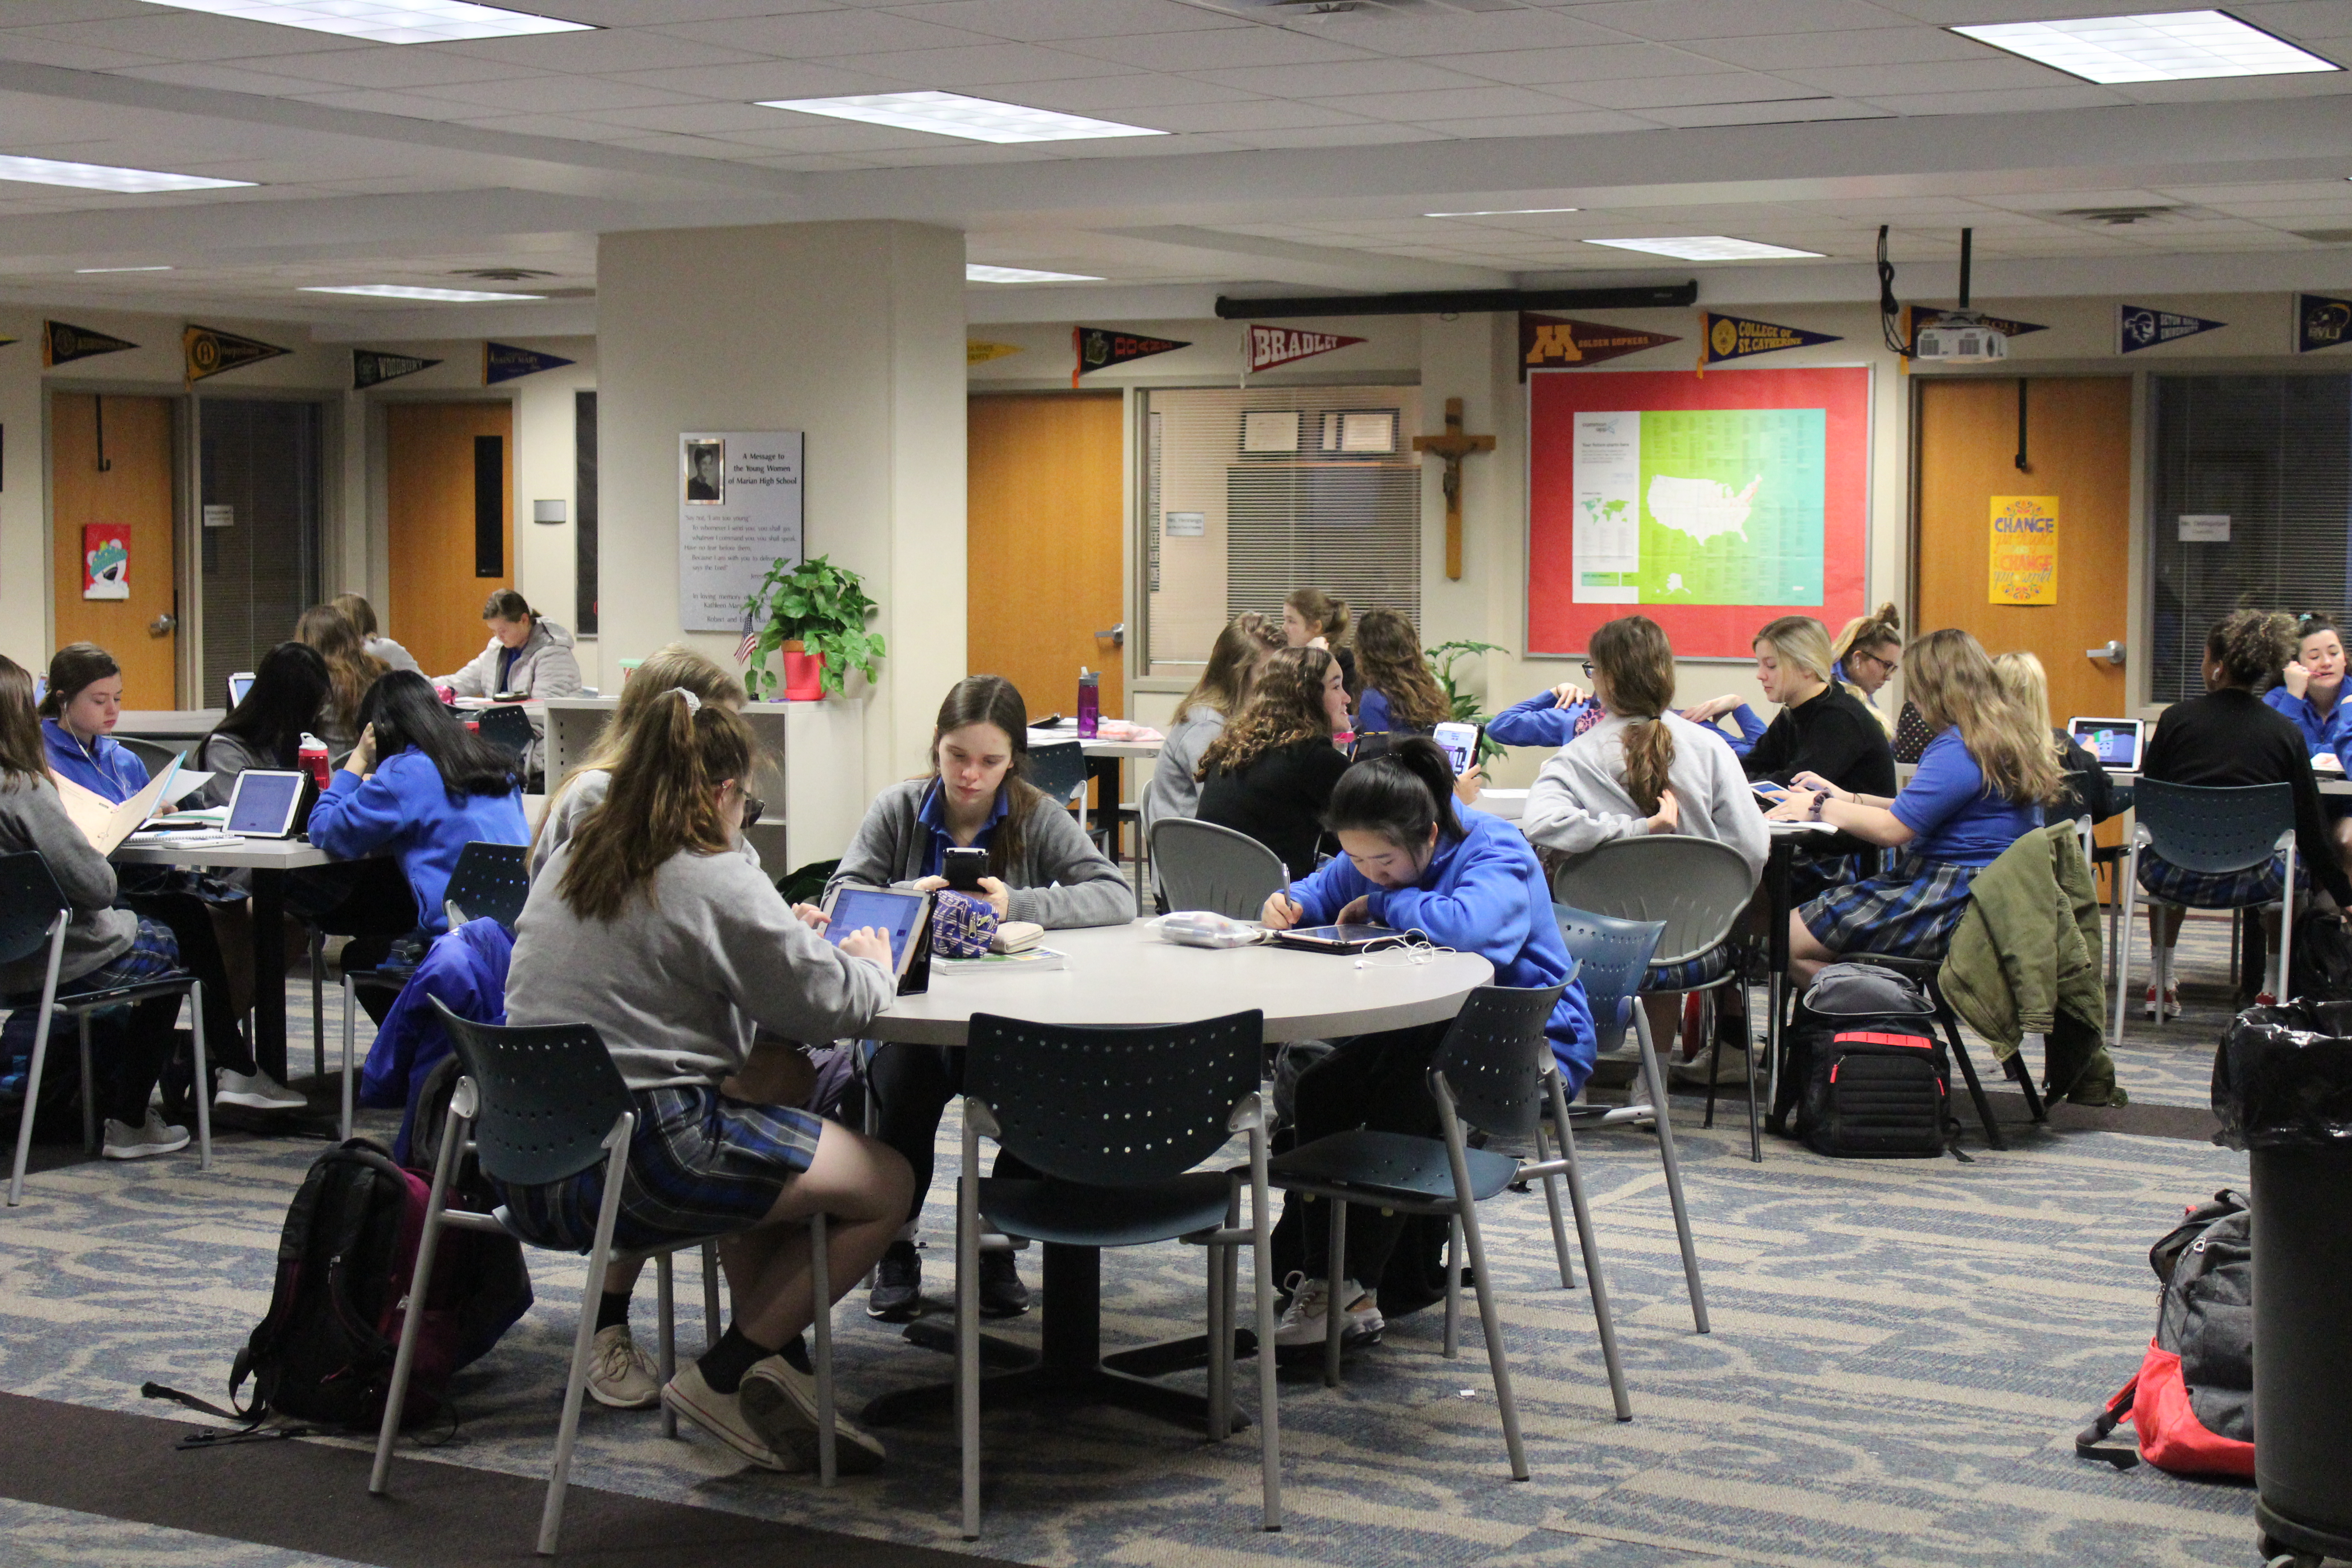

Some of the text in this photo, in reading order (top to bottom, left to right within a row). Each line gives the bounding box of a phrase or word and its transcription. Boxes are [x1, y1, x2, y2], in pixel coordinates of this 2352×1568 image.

[1739, 321, 1793, 338] COLLEGE OF
[1253, 328, 1338, 367] BRADLEY
[1578, 336, 1649, 348] GOLDEN GOPHERS
[1752, 338, 1804, 351] CATHERINE
[378, 357, 423, 379] WOODBURY
[750, 453, 776, 461] Message
[746, 466, 764, 474] Young
[760, 478, 774, 486] High
[1994, 517, 2055, 533] CHANGE
[1999, 554, 2053, 572] CHANGE
